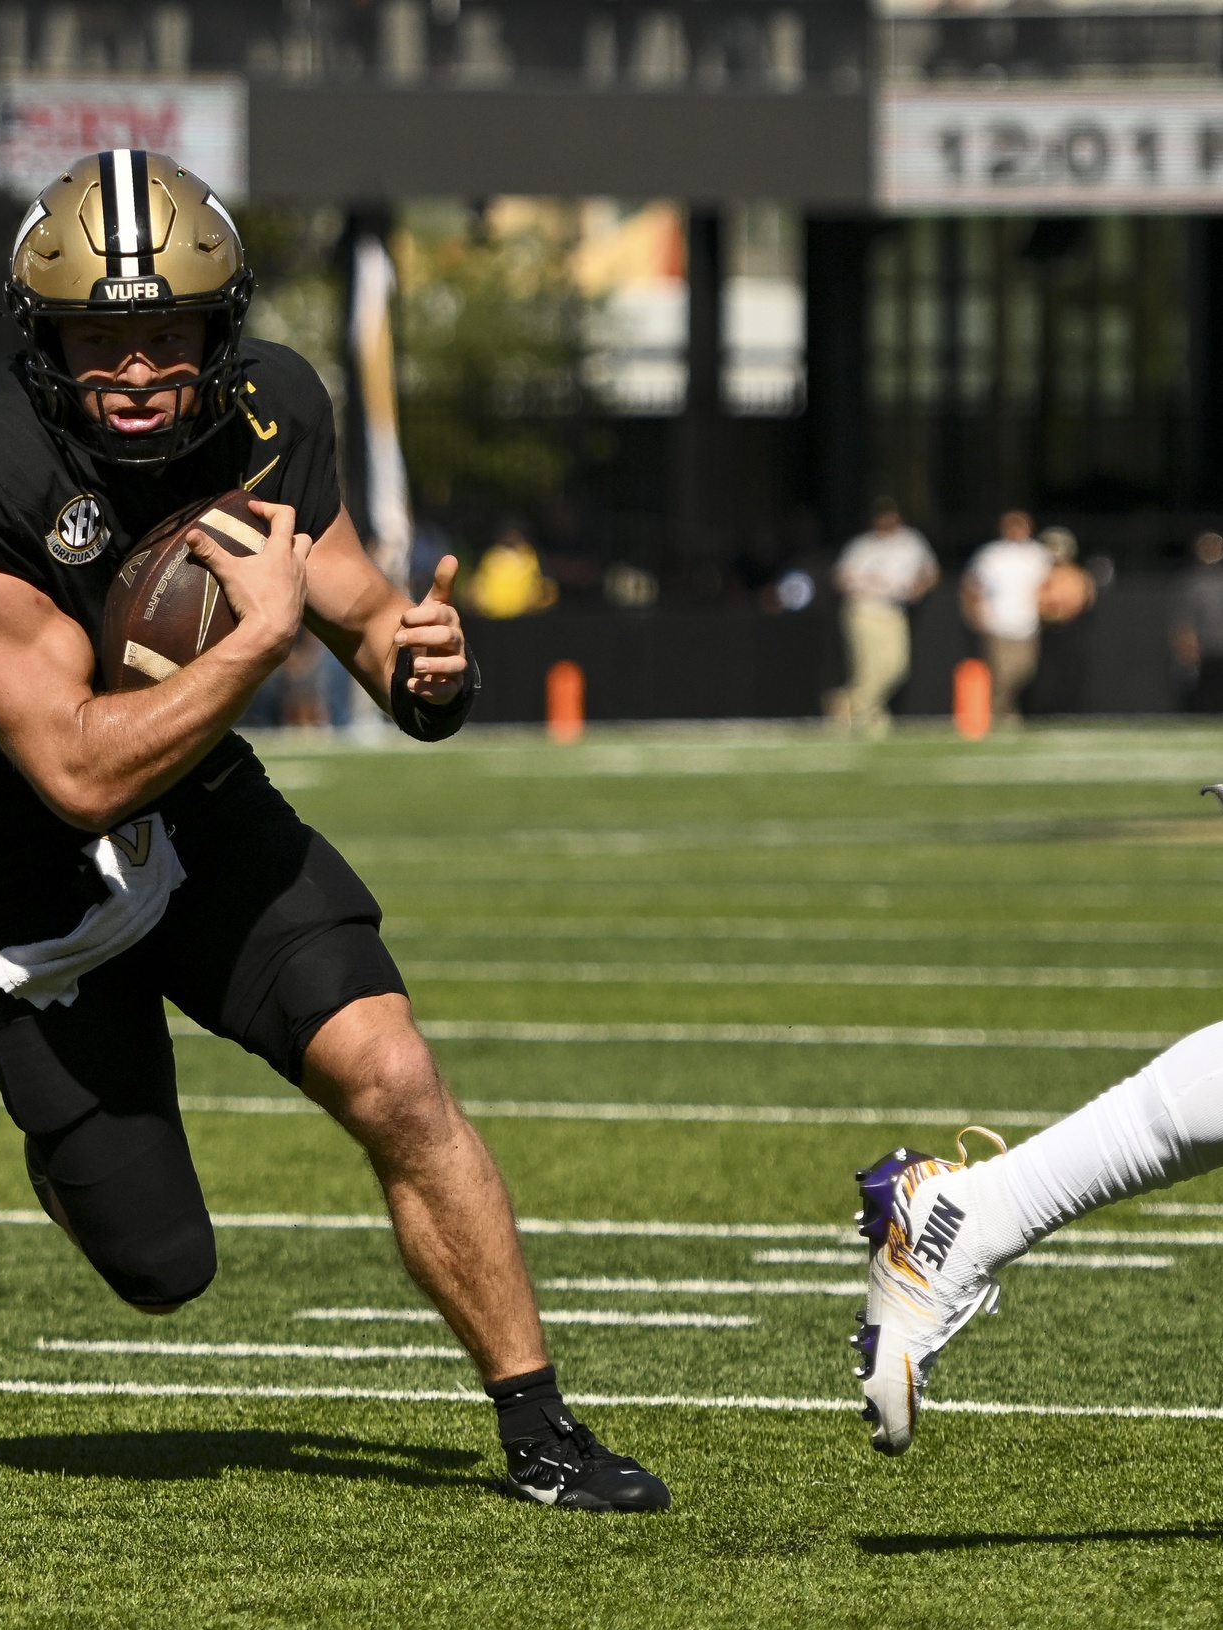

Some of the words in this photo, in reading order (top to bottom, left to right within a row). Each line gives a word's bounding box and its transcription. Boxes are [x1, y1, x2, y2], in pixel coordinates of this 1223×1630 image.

[104, 282, 159, 300] VUFB
[237, 380, 278, 440] C
[61, 499, 100, 547] SEC
[52, 543, 104, 564] GRADUATE
[911, 1192, 967, 1273] NIKE
